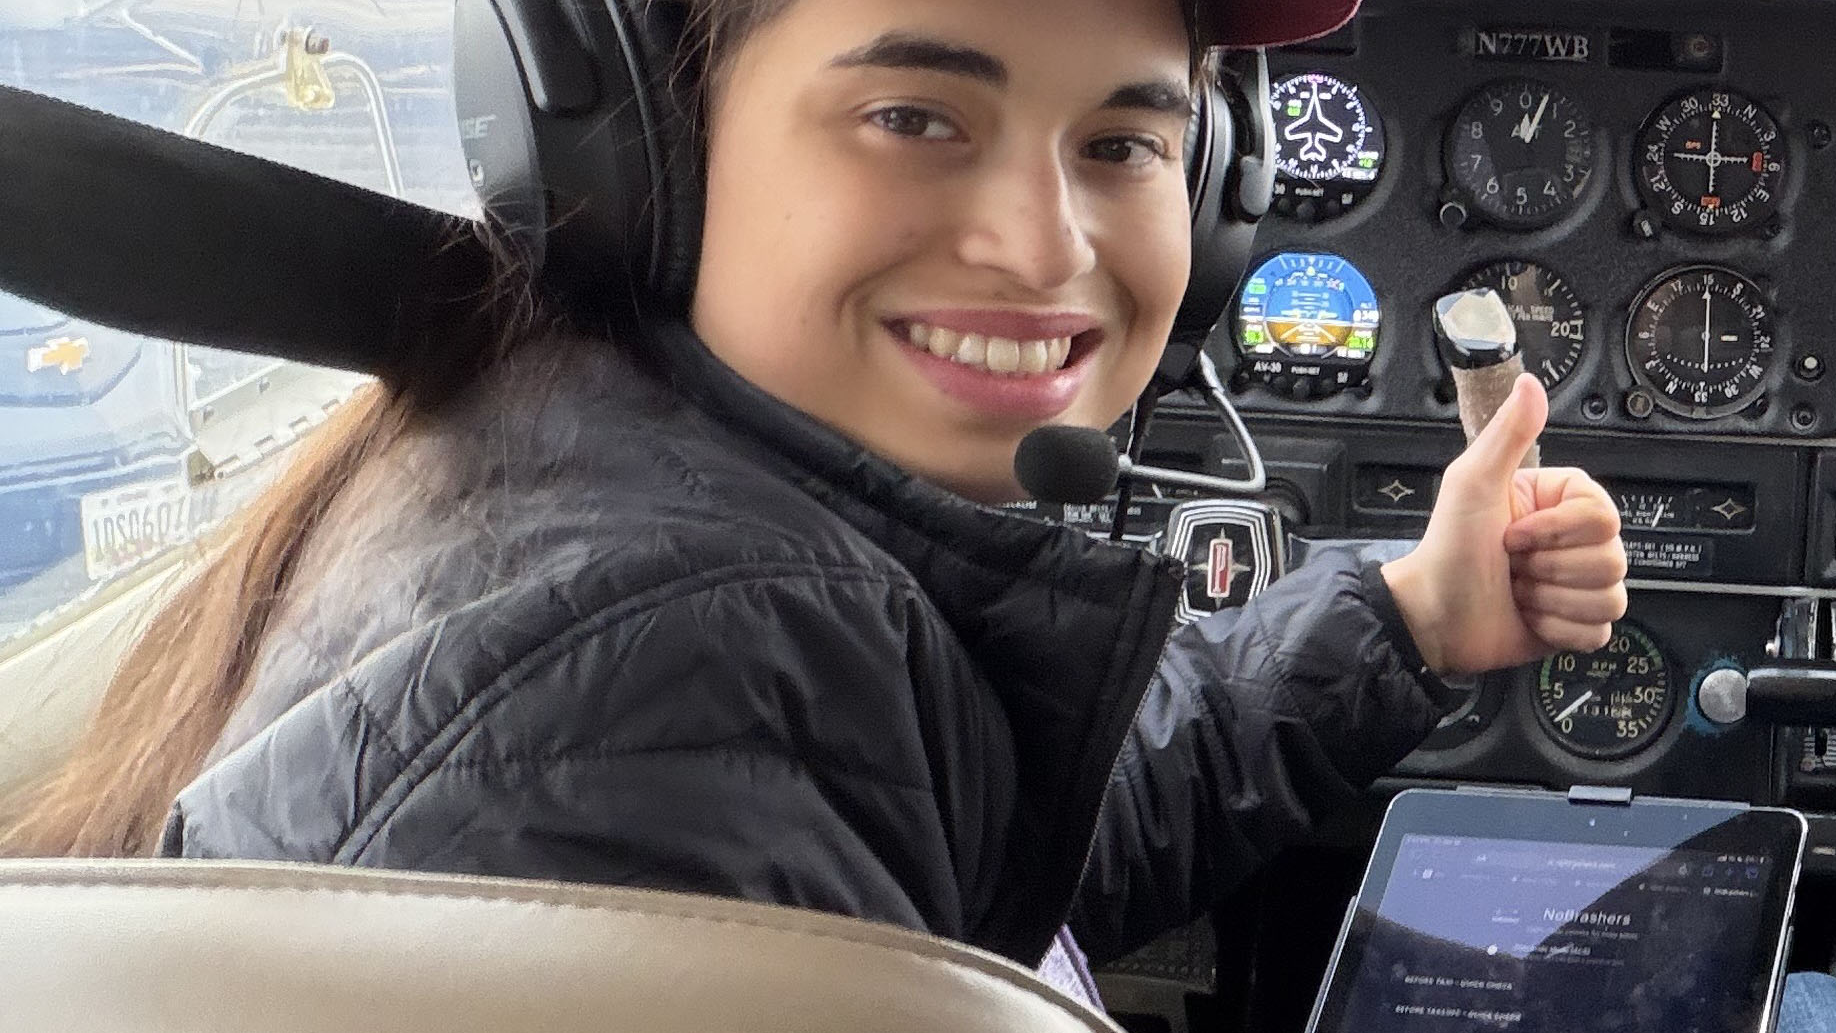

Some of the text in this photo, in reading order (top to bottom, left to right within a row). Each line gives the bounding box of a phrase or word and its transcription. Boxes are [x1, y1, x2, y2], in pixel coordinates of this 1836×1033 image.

[1477, 32, 1589, 58] N777WB
[1490, 98, 1503, 116] 9
[1519, 91, 1532, 109] 0
[1681, 97, 1698, 113] 30
[1712, 94, 1729, 107] 33
[1743, 104, 1757, 120] N
[1471, 121, 1483, 139] 8
[1563, 120, 1576, 138] 2
[1470, 154, 1482, 172] 7
[1563, 164, 1574, 182] 3
[1486, 177, 1499, 194] 6
[1543, 180, 1556, 197] 4
[1516, 186, 1528, 205] 5
[1551, 321, 1570, 337] 20
[1609, 635, 1630, 653] 20
[1557, 654, 1576, 672] 10
[1627, 655, 1649, 675] 25
[1553, 682, 1564, 700] 5
[1633, 686, 1656, 704] 30
[1561, 717, 1573, 734] 0
[1616, 719, 1639, 738] 35
[1542, 907, 1633, 926] NoBrashers
